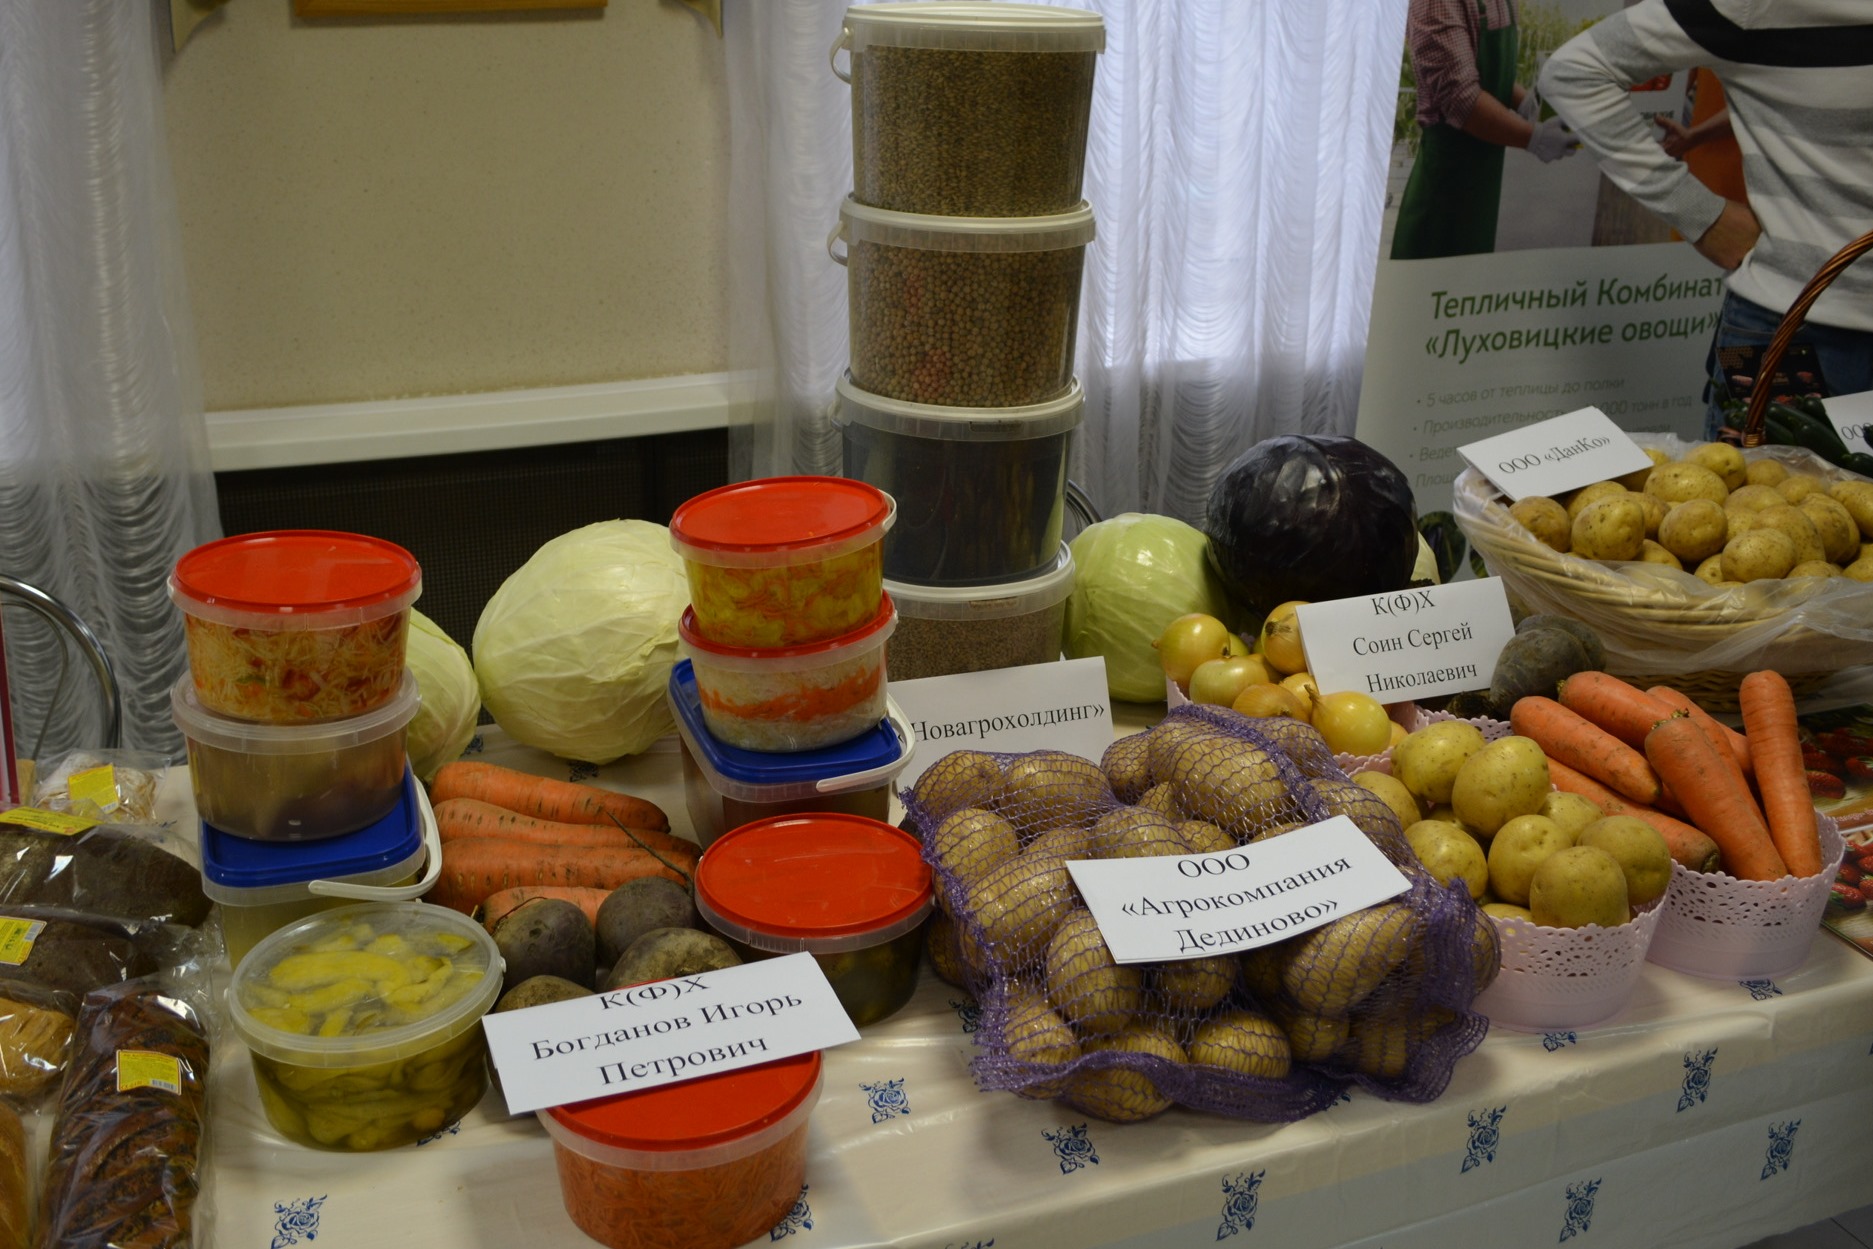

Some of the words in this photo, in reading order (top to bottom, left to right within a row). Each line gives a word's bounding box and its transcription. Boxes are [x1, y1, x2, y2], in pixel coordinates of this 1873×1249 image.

[1431, 280, 1588, 319] Тепличный
[1596, 273, 1722, 306] Комбинат
[1425, 323, 1614, 364] «Луховицкие
[1621, 310, 1719, 342] овощи»
[1426, 393, 1436, 408] 5
[1439, 391, 1478, 405] часов
[1481, 388, 1496, 400] от
[1500, 383, 1559, 397] теплицы
[1562, 382, 1581, 395] до
[1584, 379, 1625, 392] полки
[1424, 409, 1563, 436] Производительност
[1498, 453, 1541, 474] ООО
[1544, 437, 1610, 462] «ДанКо»
[1371, 590, 1436, 617] К(Ф)Х
[1353, 636, 1404, 656] Соин
[1407, 622, 1473, 650] Сергей
[1366, 664, 1477, 693] Николаевич
[1177, 853, 1250, 878] ООО
[1121, 857, 1353, 919] «Агрокомпания
[1173, 899, 1339, 954] Дединово»
[599, 976, 711, 1011] К(Ф)Х
[530, 1014, 691, 1061] Богданов
[698, 994, 802, 1026] Игорь
[596, 1037, 769, 1086] Петрович
